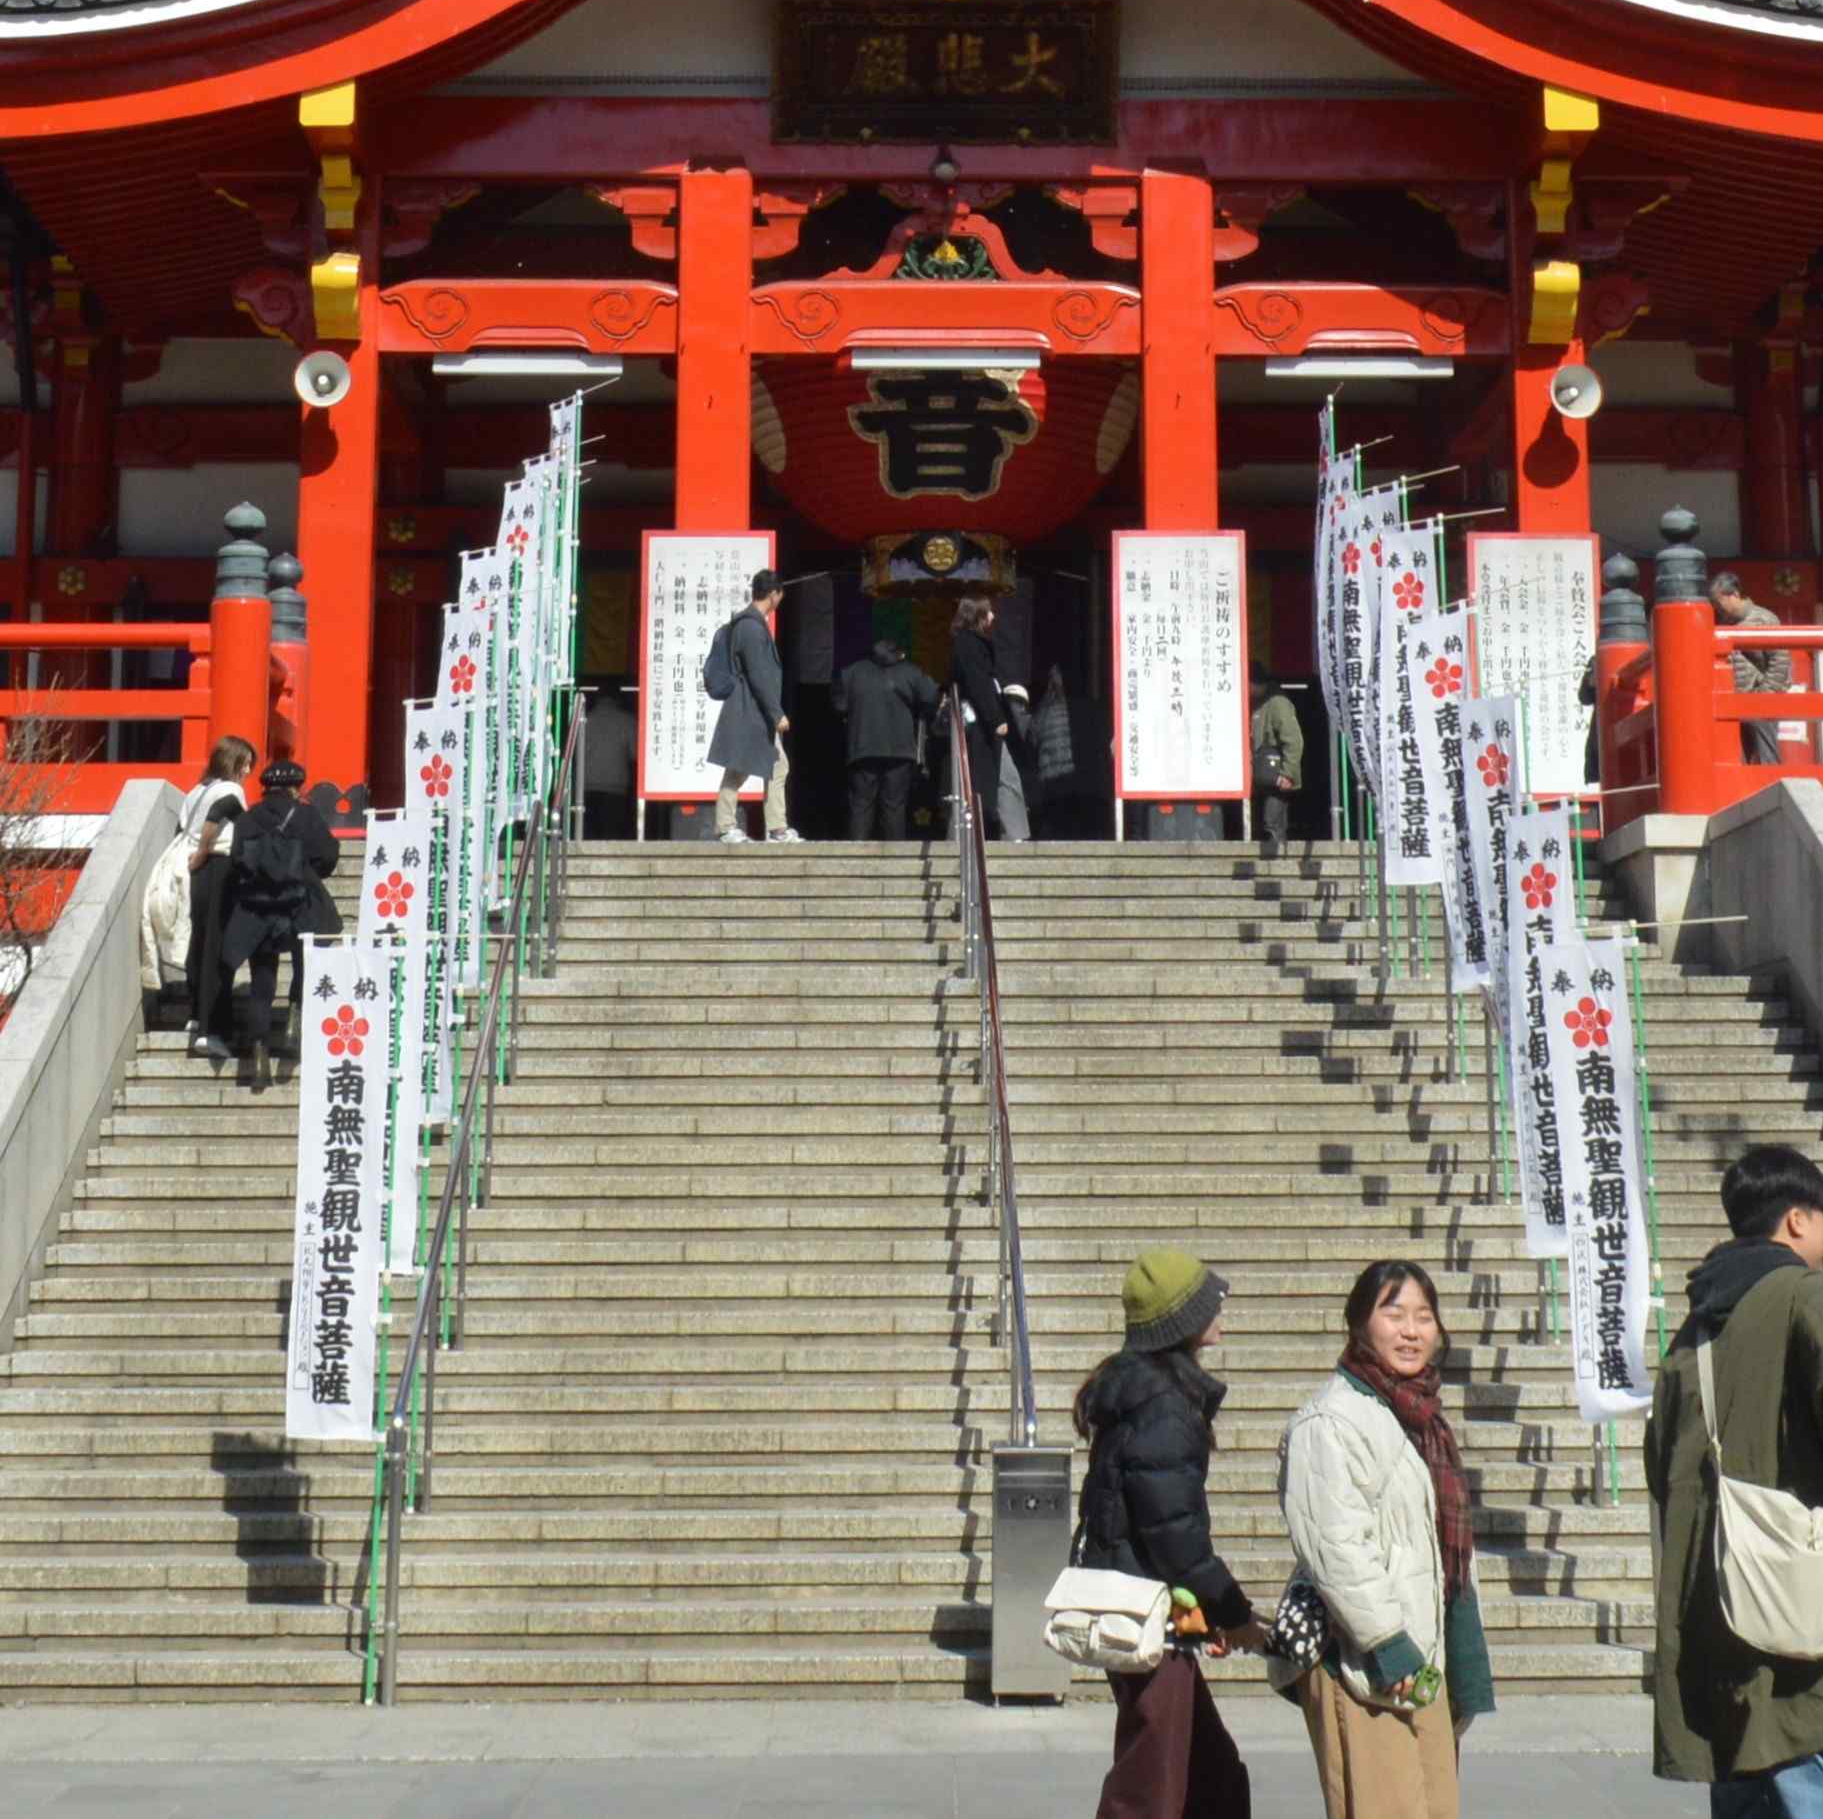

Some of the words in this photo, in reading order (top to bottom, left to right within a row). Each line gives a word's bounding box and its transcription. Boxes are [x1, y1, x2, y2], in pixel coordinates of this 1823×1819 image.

[1388, 551, 1427, 569] 奉納
[1415, 634, 1463, 661] 奉納
[413, 730, 458, 752] 奉納
[1467, 718, 1512, 742] 奉納
[370, 846, 421, 869] 奉納
[1513, 838, 1562, 863] 奉納
[313, 974, 379, 1002] 奉納
[1551, 968, 1616, 996] 奉納
[311, 1059, 366, 1405] 南無聖観世音菩薩
[1576, 1051, 1634, 1391] 南無聖観世音菩薩
